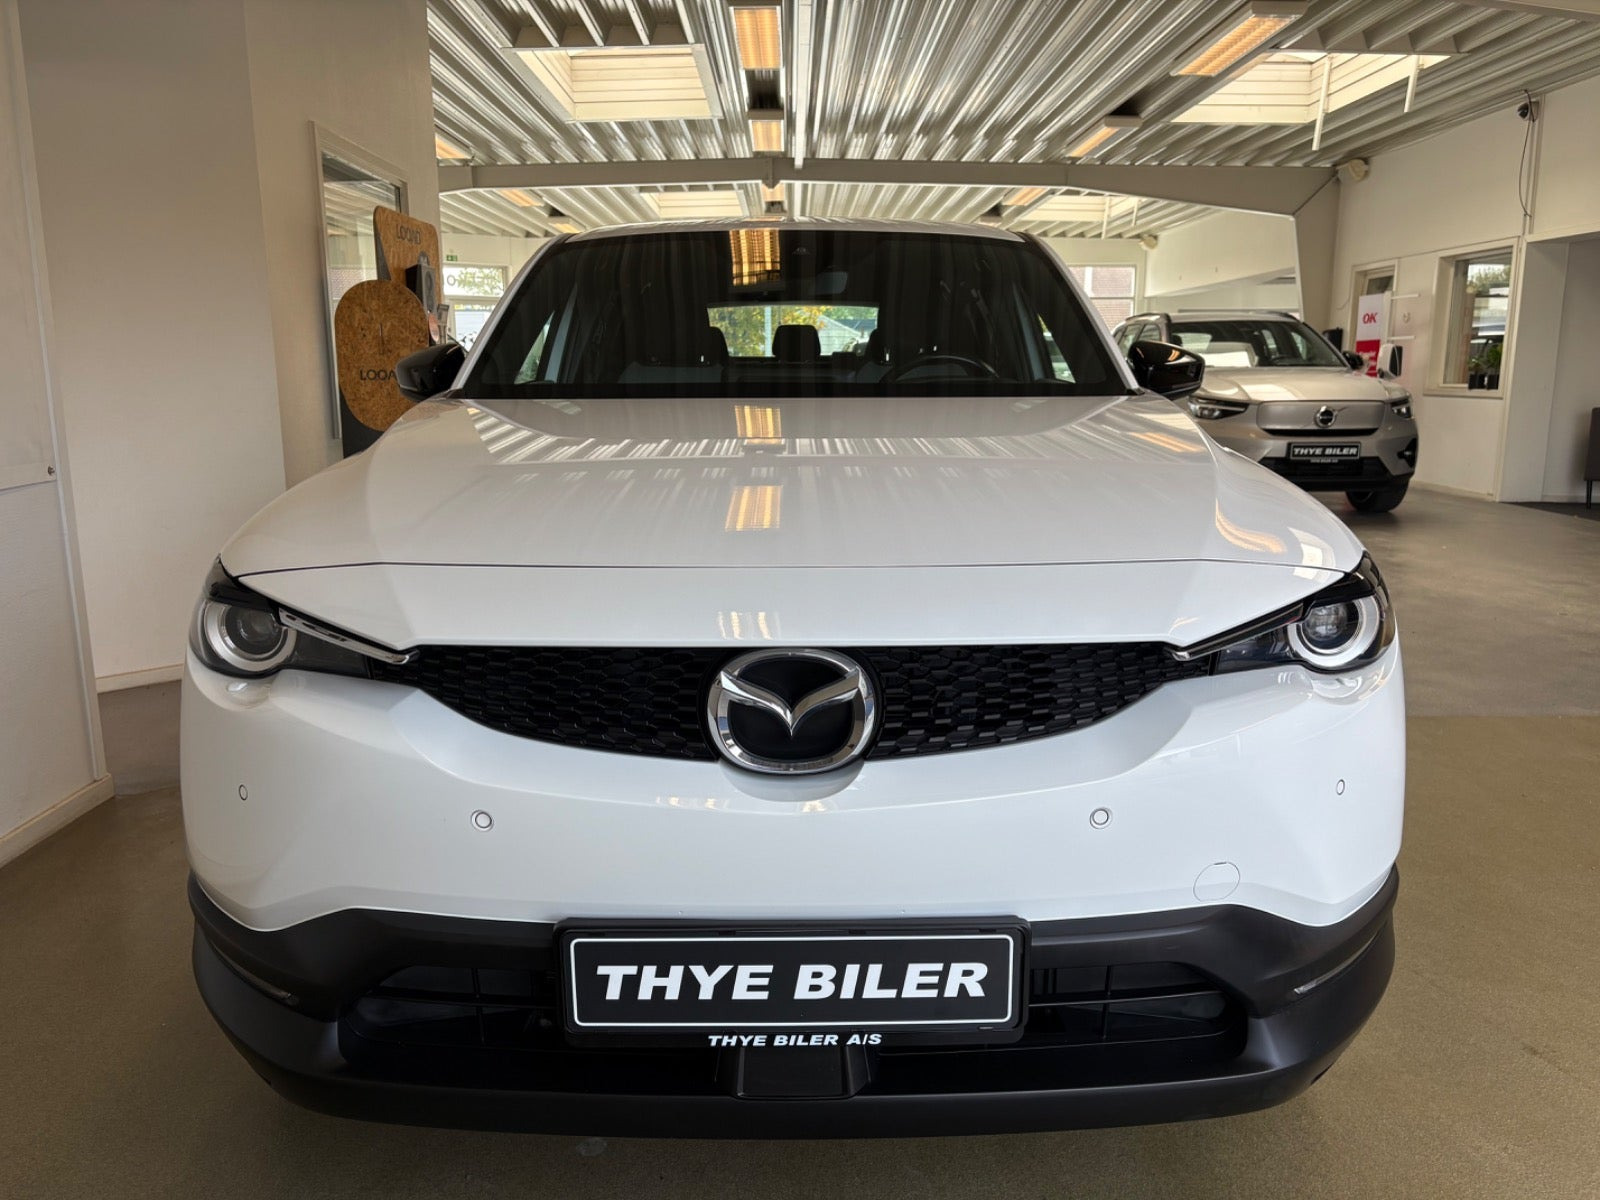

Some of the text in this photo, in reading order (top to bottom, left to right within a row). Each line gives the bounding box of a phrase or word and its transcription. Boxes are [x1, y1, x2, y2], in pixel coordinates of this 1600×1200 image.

[1362, 312, 1377, 324] OK
[360, 369, 397, 381] LOOA
[1294, 447, 1357, 455] THYE BILER
[596, 962, 988, 1000] THYE BILER
[708, 1033, 882, 1047] THYE BILER A/S
